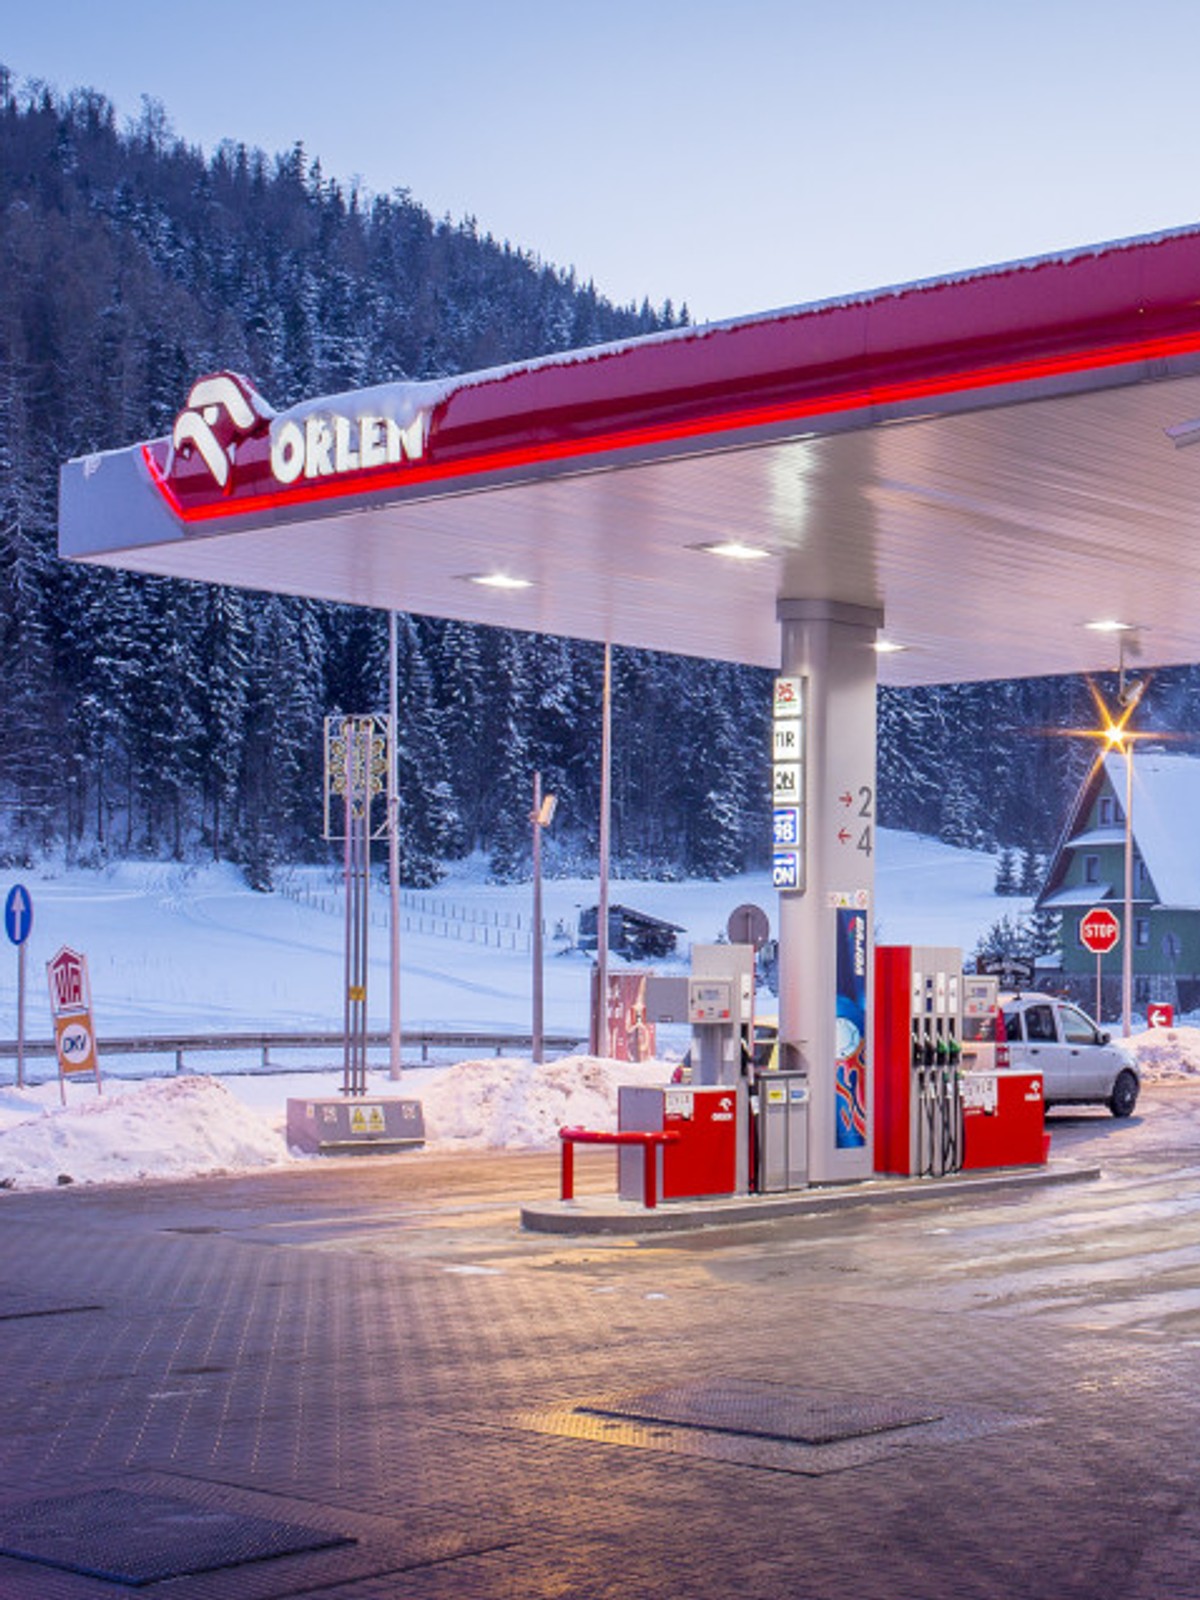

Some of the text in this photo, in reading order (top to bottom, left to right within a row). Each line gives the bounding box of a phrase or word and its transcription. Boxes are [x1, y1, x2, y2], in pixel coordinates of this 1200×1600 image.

[271, 410, 423, 484] ORLEN
[858, 786, 872, 817] 2
[773, 820, 795, 841] 98
[857, 826, 872, 858] 4
[773, 866, 795, 885] ON
[1084, 924, 1116, 938] STOP
